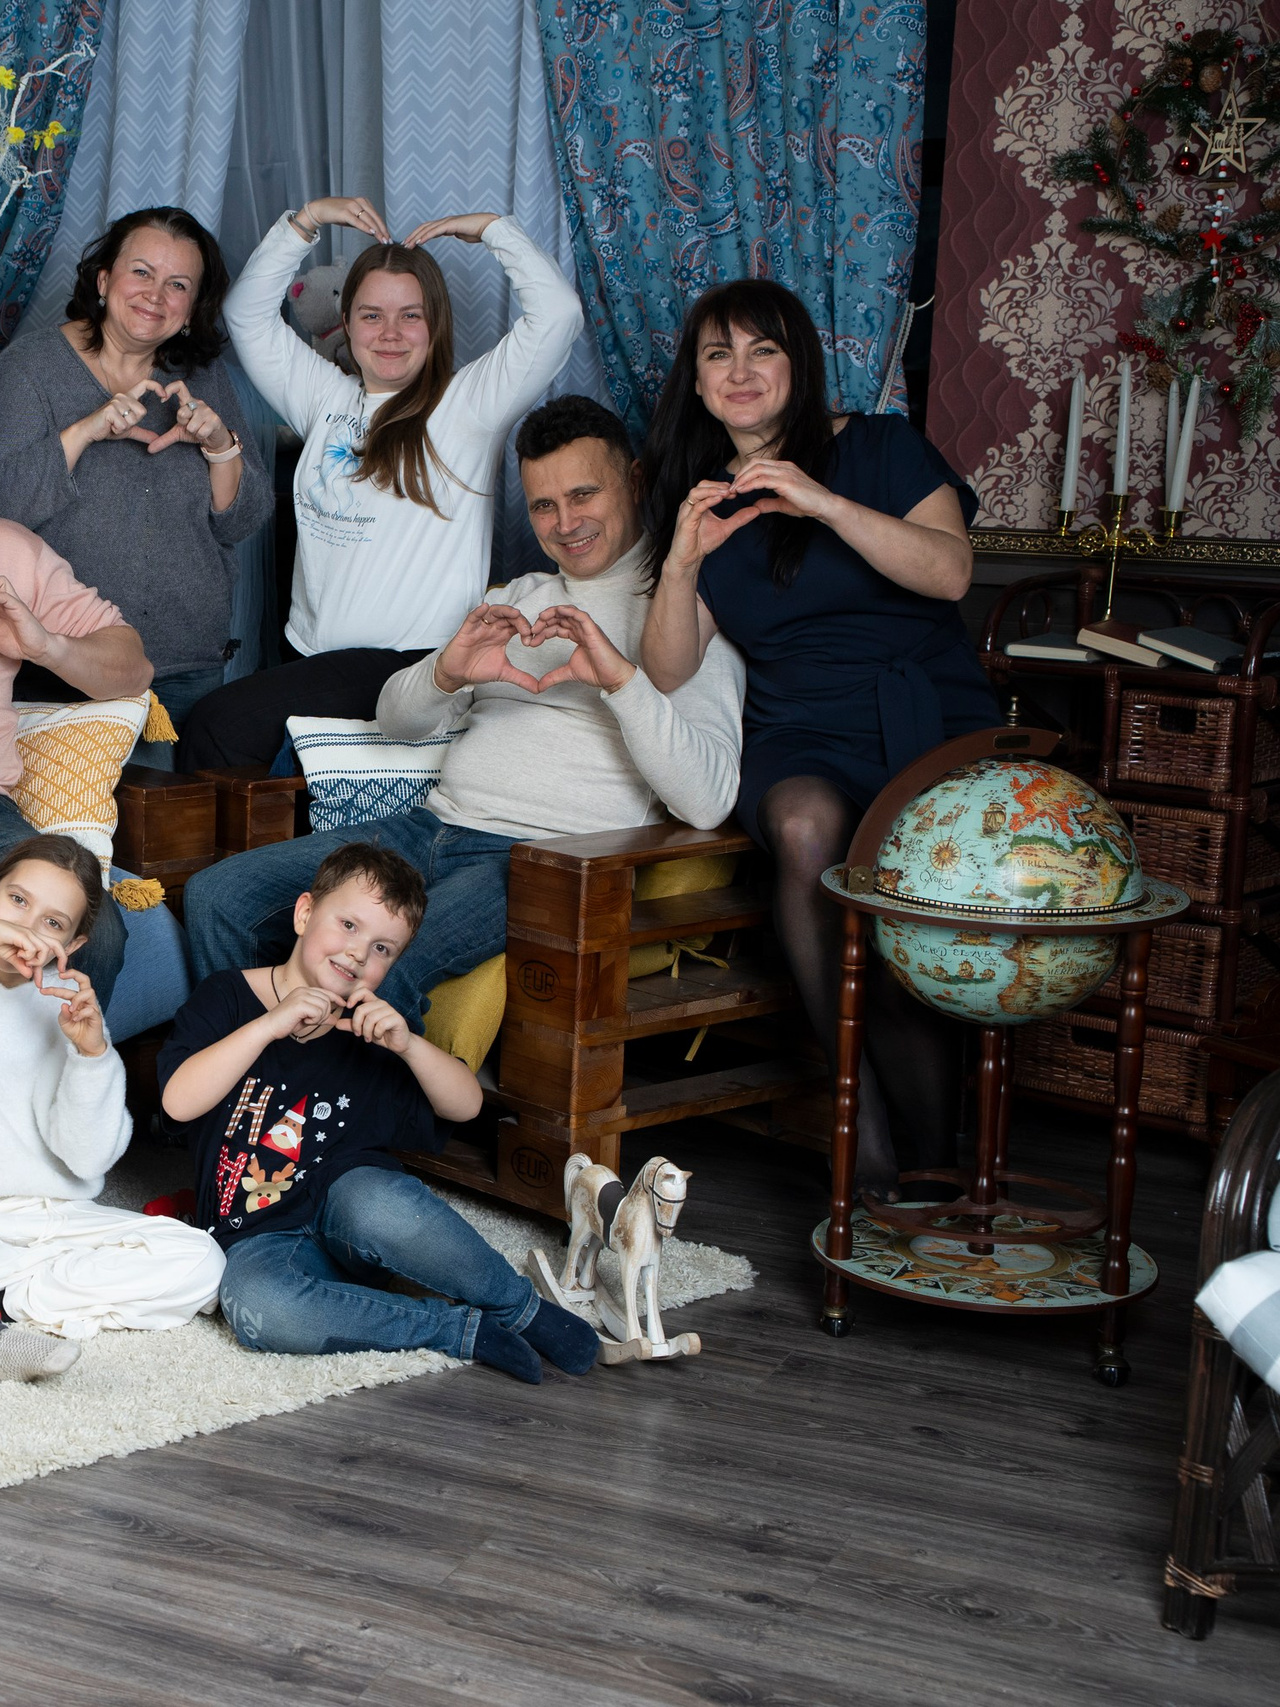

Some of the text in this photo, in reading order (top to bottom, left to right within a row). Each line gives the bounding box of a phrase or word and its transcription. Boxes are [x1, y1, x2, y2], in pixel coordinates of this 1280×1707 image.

[331, 511, 352, 523] dreams
[352, 513, 377, 527] happen
[1015, 859, 1048, 869] AFRICA
[524, 967, 555, 995] EUR
[518, 1152, 549, 1180] EUR
